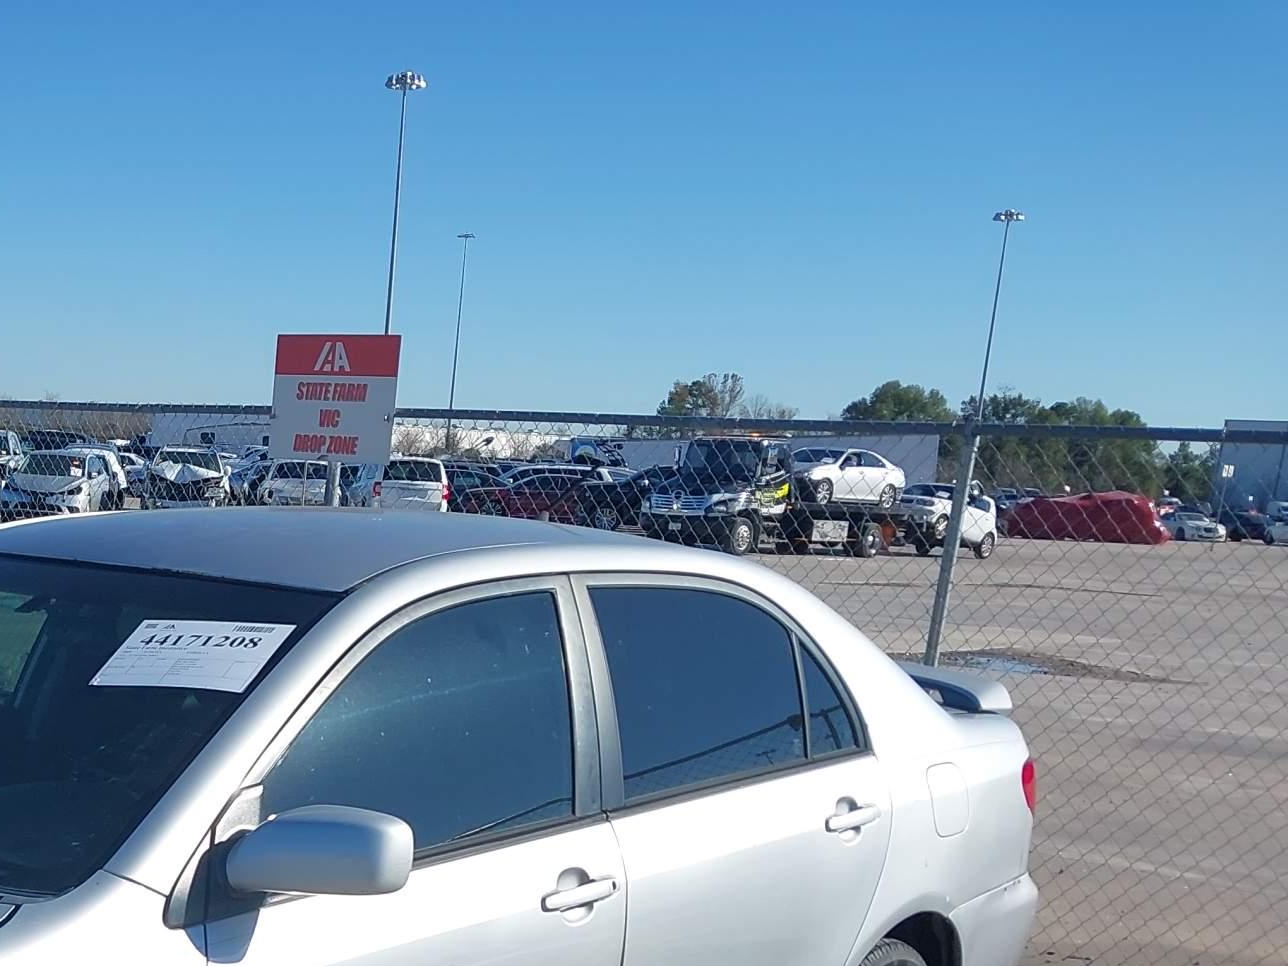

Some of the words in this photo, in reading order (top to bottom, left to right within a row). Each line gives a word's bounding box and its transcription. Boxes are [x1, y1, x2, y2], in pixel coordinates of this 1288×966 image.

[296, 381, 332, 402] STATE
[332, 383, 368, 402] FARM
[319, 408, 341, 428] VIC
[293, 433, 327, 453] DROP
[327, 436, 359, 455] ZONE
[140, 633, 263, 649] 44171208
